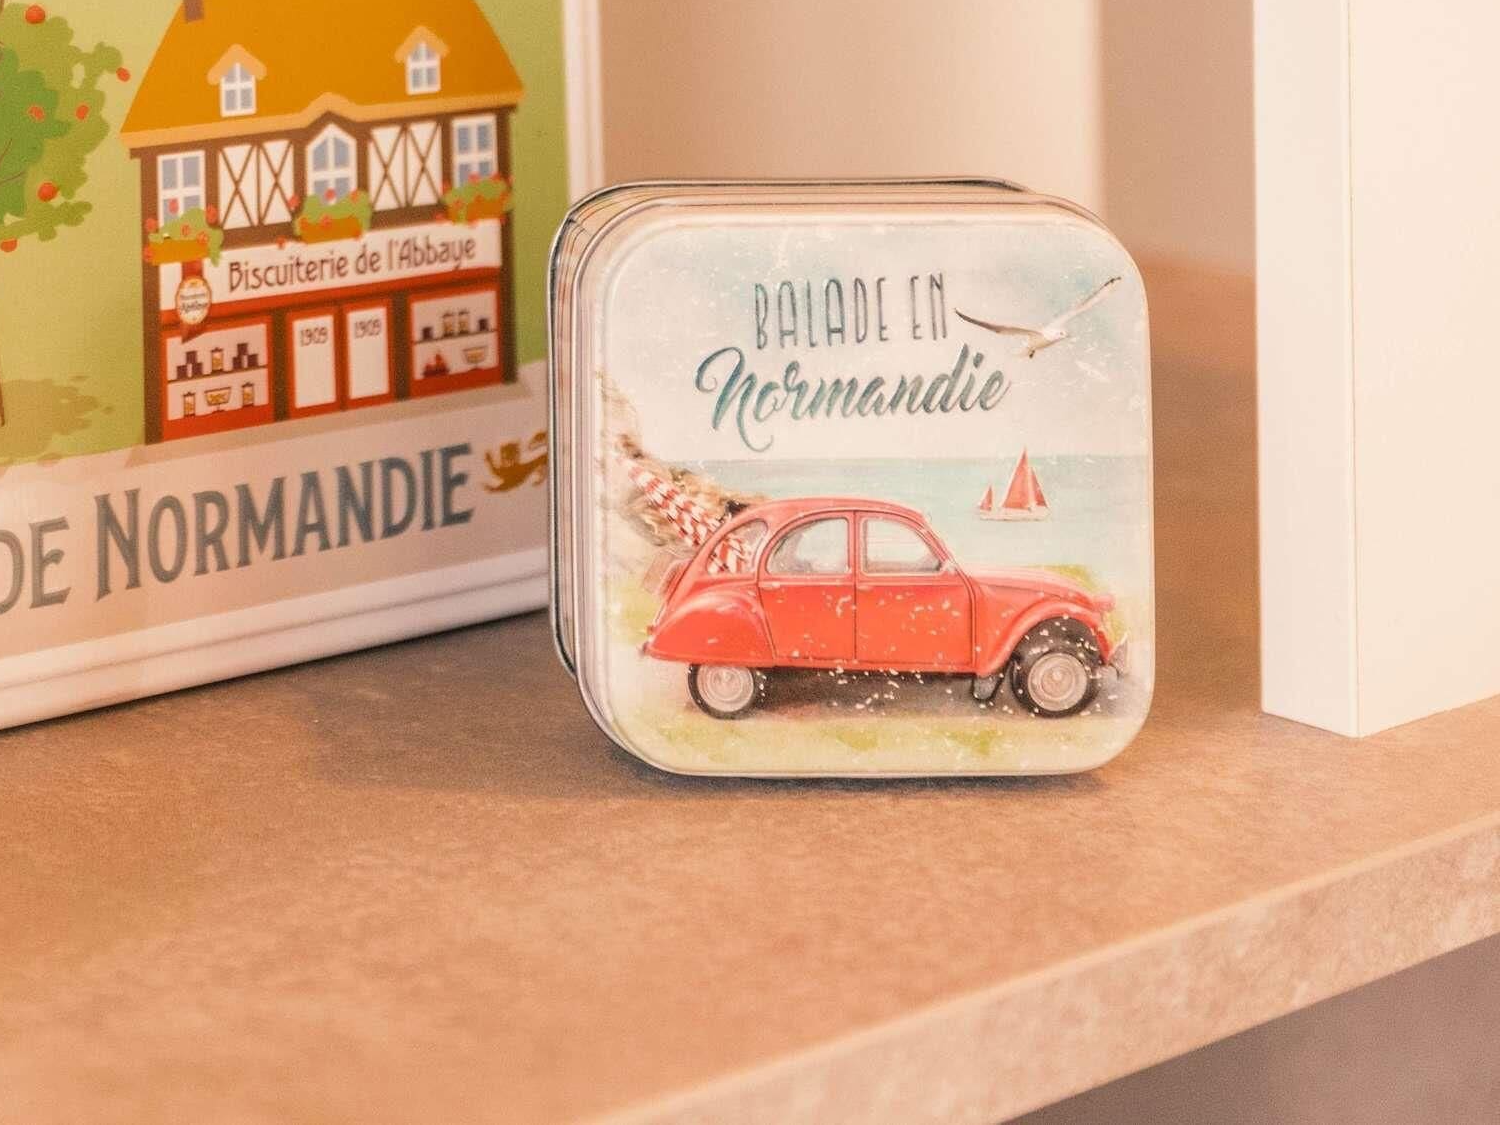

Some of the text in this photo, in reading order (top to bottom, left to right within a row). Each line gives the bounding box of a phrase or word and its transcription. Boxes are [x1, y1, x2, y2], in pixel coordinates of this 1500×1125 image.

[228, 233, 477, 293] Biscuiterie de l'Abbaye
[753, 272, 949, 350] BALADE EN
[694, 343, 1012, 453] Normandie
